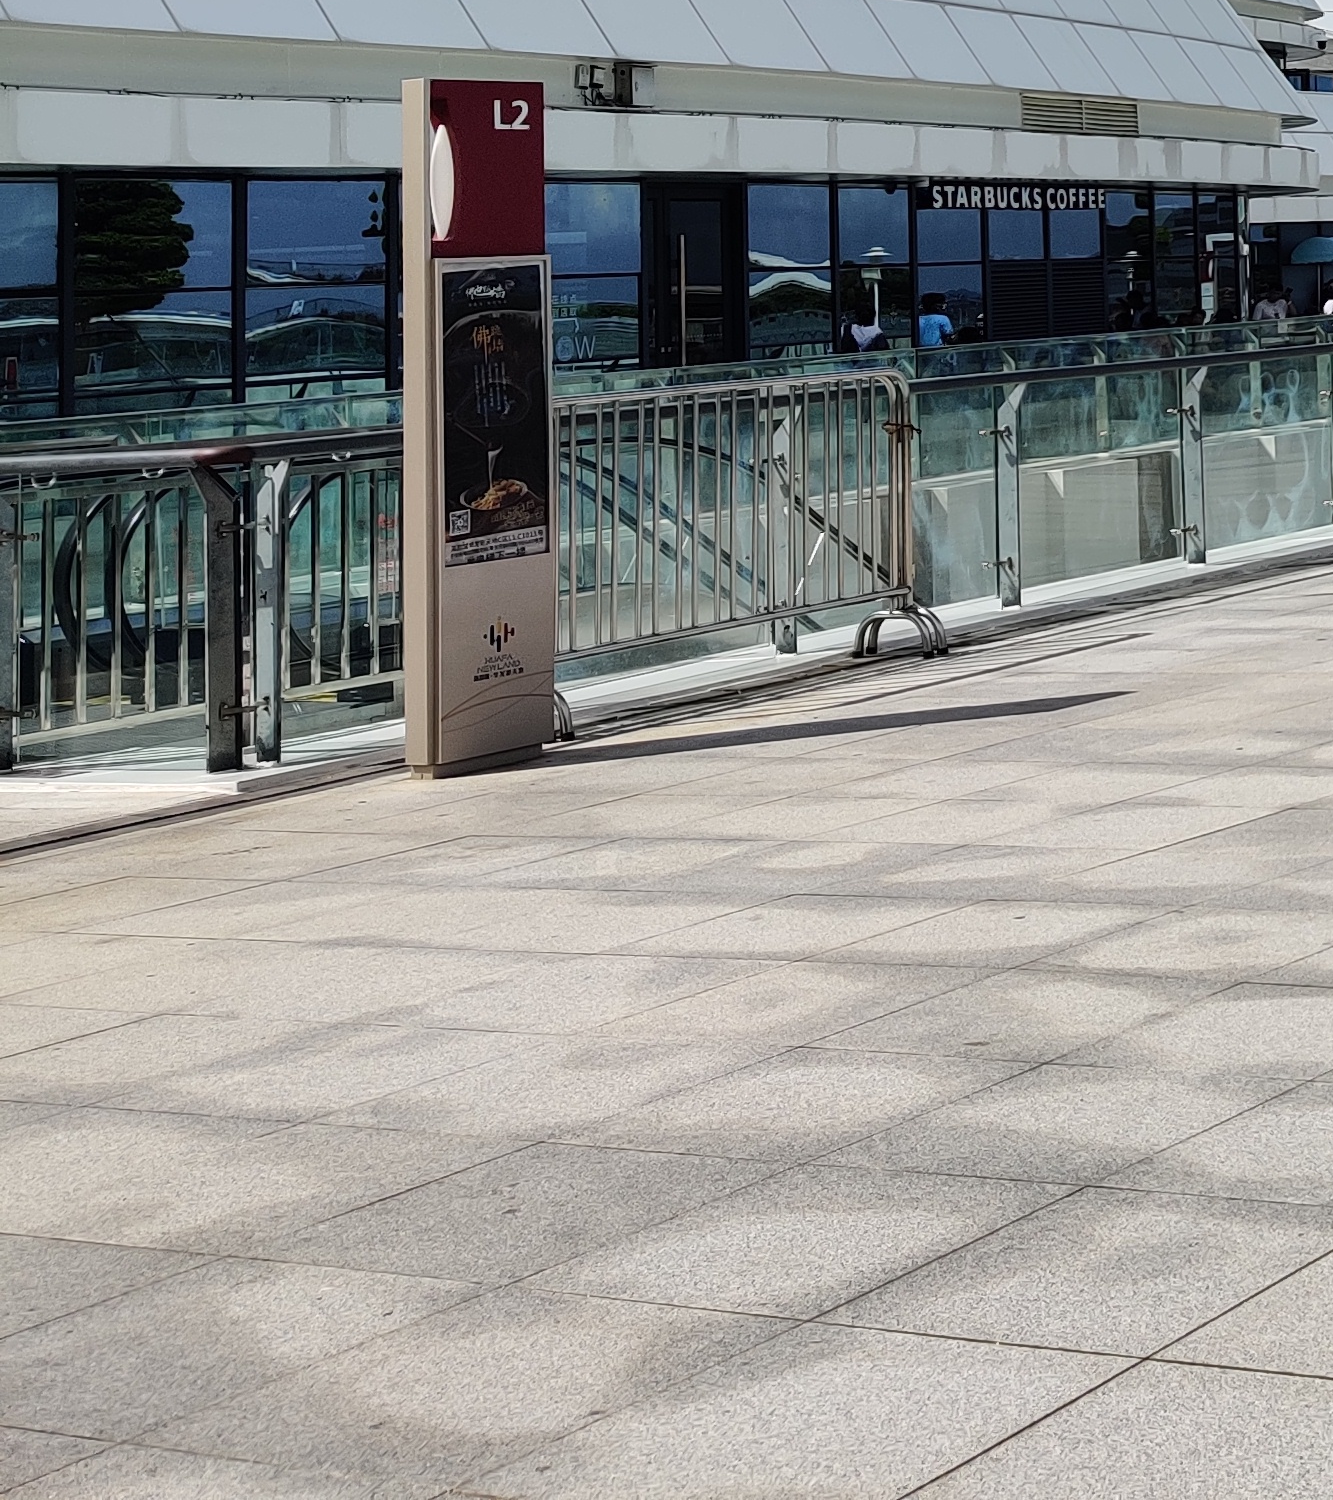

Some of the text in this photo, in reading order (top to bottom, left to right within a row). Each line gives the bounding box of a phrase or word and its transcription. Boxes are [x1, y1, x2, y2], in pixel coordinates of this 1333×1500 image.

[494, 99, 530, 130] L2
[932, 185, 1106, 209] STARBUCKS COFFEE
[477, 660, 521, 673] NEWLAND
